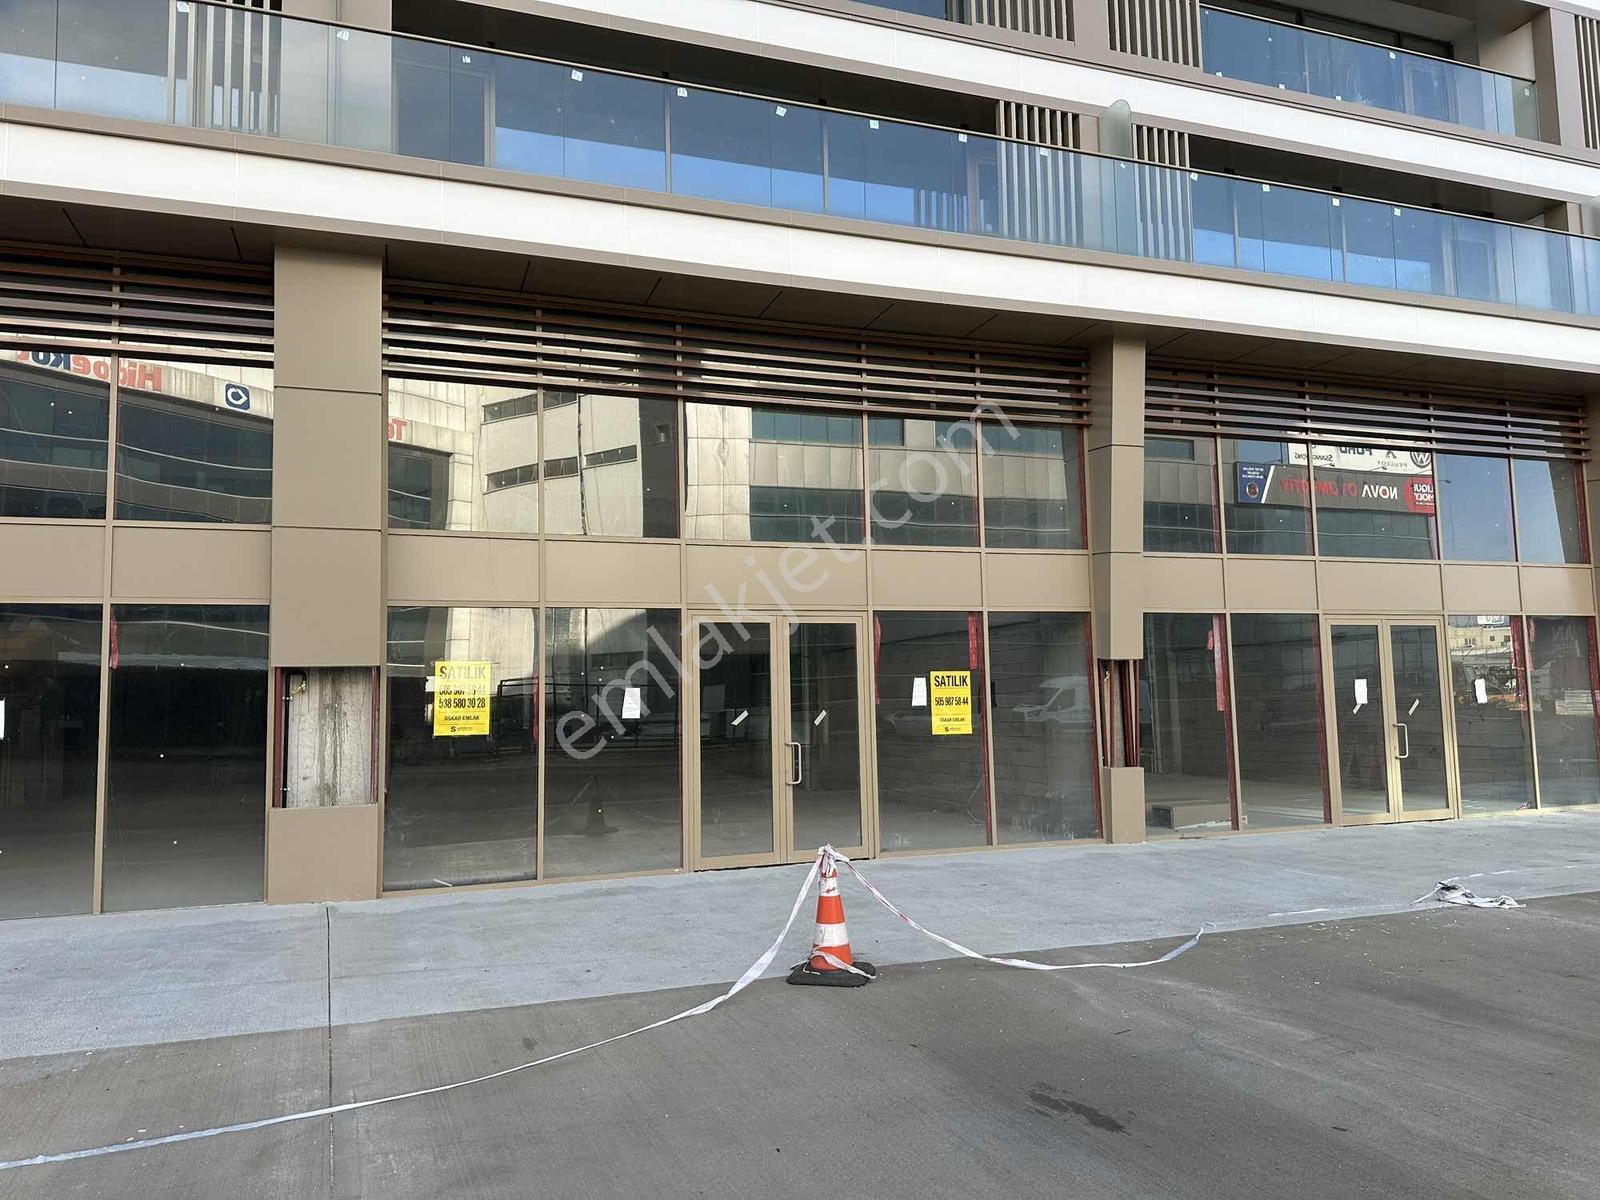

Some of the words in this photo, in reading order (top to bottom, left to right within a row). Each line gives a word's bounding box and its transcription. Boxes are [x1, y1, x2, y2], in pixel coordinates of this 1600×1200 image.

[439, 665, 486, 680] SATILIK
[934, 675, 968, 687] SATILIK
[439, 698, 452, 708] 538
[453, 698, 466, 708] 580
[467, 698, 476, 708] 30
[477, 697, 486, 708] 28
[935, 697, 944, 706] 505
[945, 697, 954, 706] 987
[955, 697, 962, 706] 58
[962, 697, 969, 706] 44
